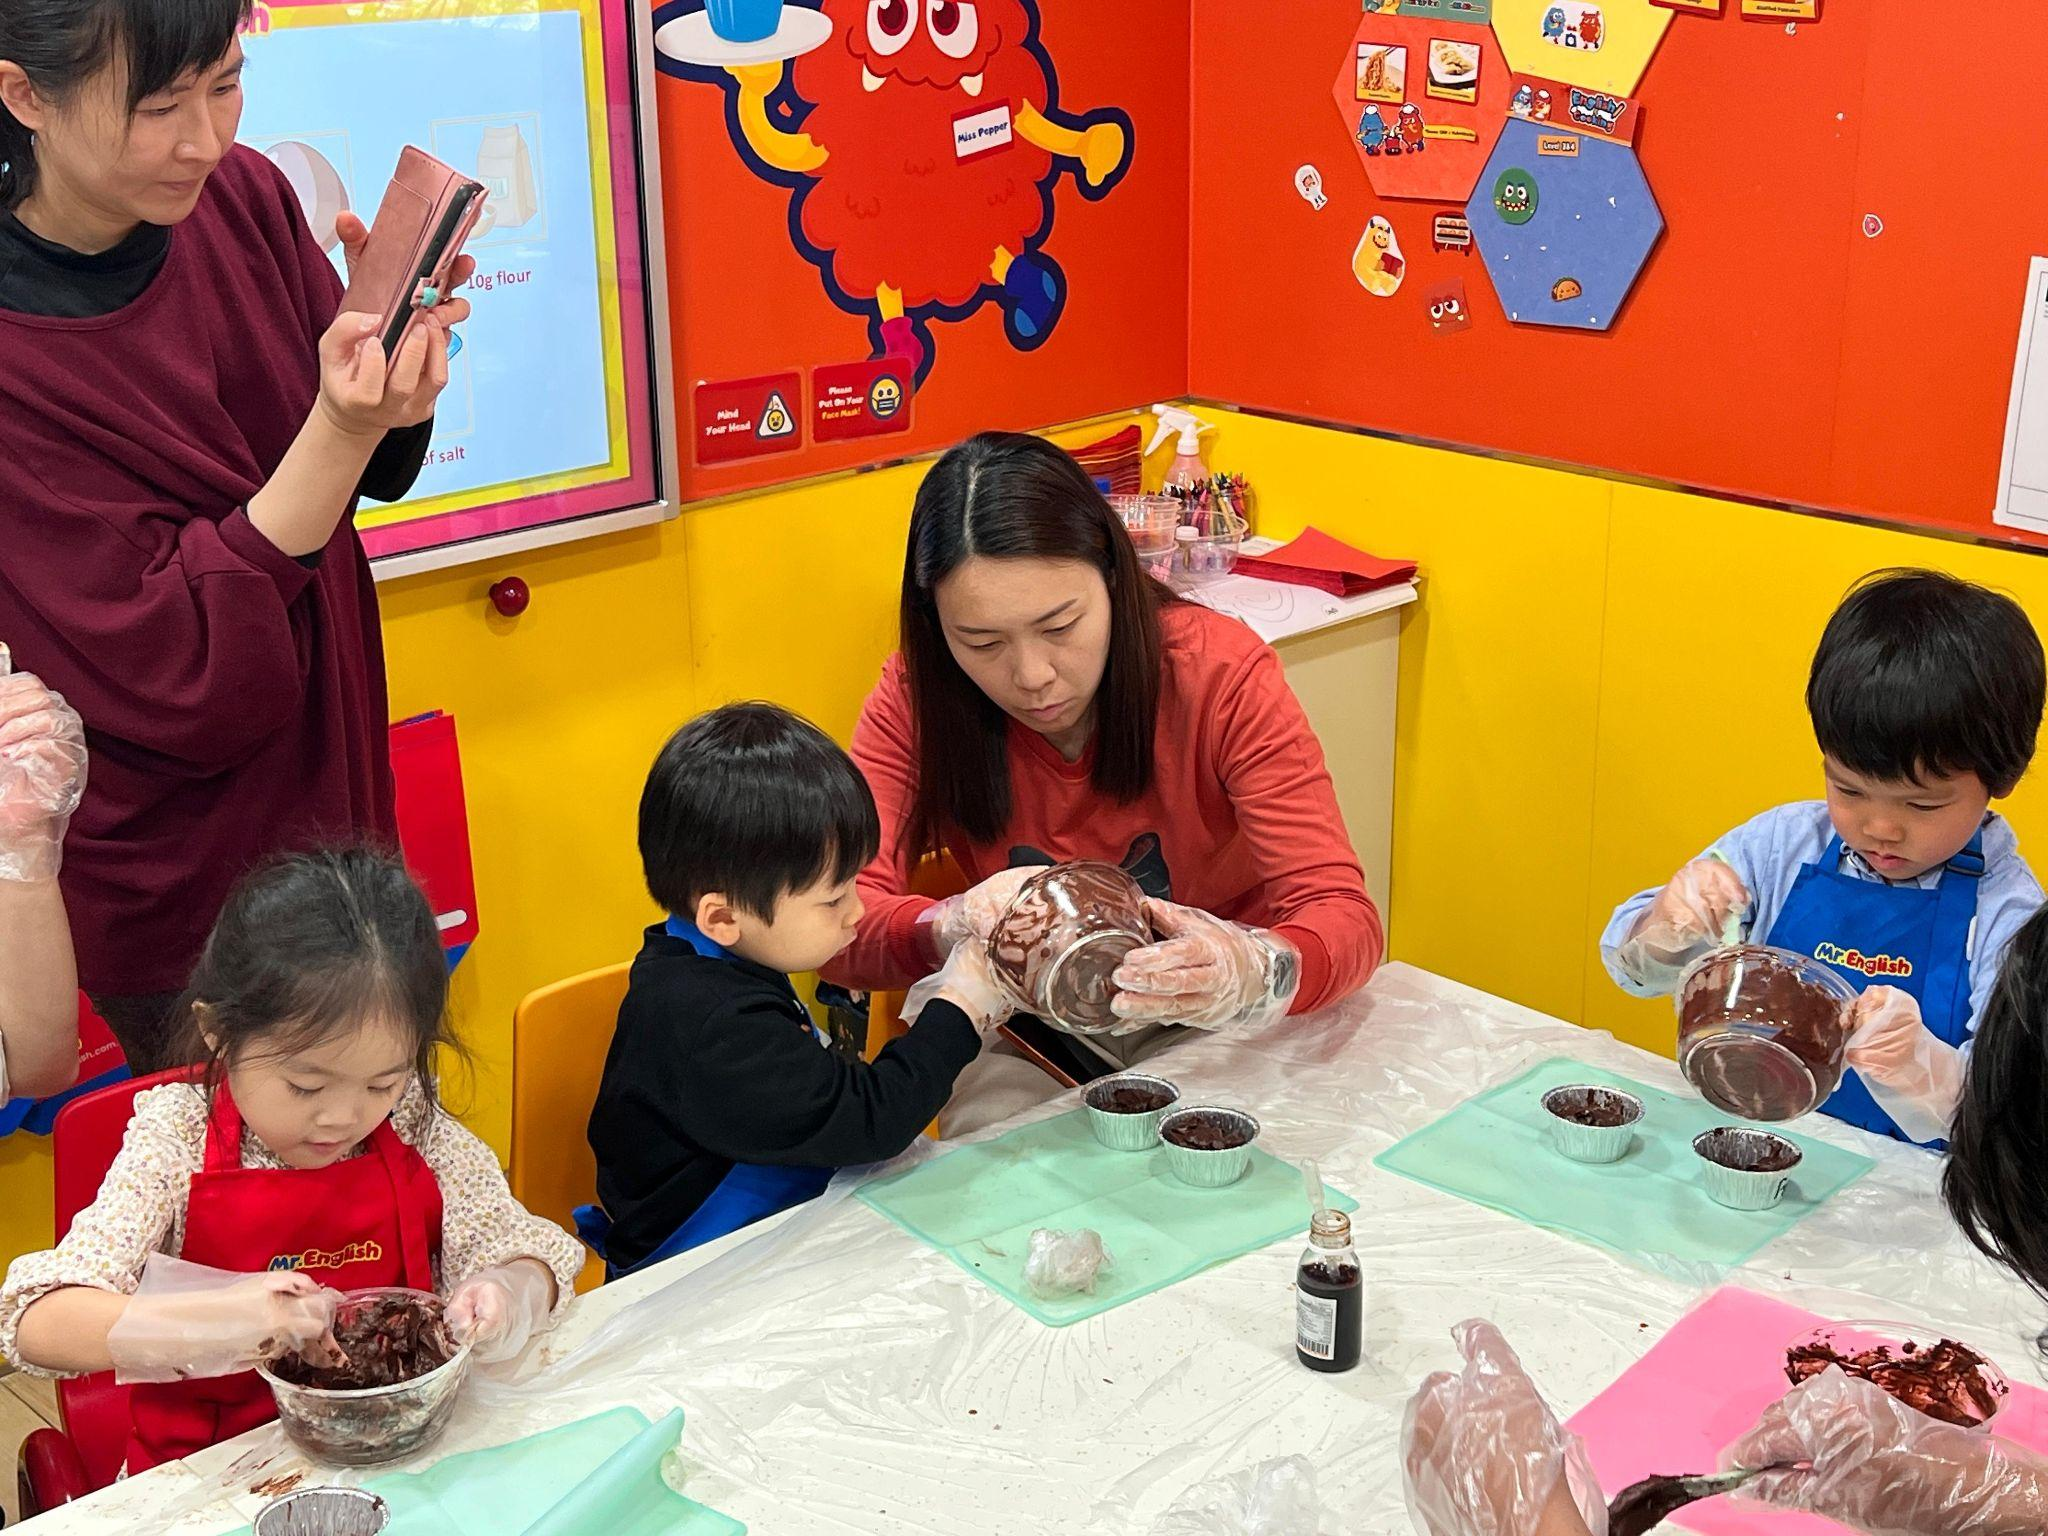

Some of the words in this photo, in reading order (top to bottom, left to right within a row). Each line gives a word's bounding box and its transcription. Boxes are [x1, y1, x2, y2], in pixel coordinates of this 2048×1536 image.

[1571, 89, 1617, 115] English
[1573, 110, 1614, 132] Cooking
[957, 131, 977, 144] Miss
[978, 121, 1008, 137] Pepper
[468, 273, 493, 290] 10g
[497, 270, 532, 285] flour
[828, 386, 853, 396] Please
[818, 400, 832, 409] Put
[834, 398, 846, 406] On
[847, 396, 865, 405] Your
[717, 408, 739, 420] Mind
[822, 411, 839, 420] Face
[841, 407, 861, 417] Mask!
[705, 425, 727, 436] Your
[729, 420, 751, 432] Head
[439, 446, 465, 463] salt
